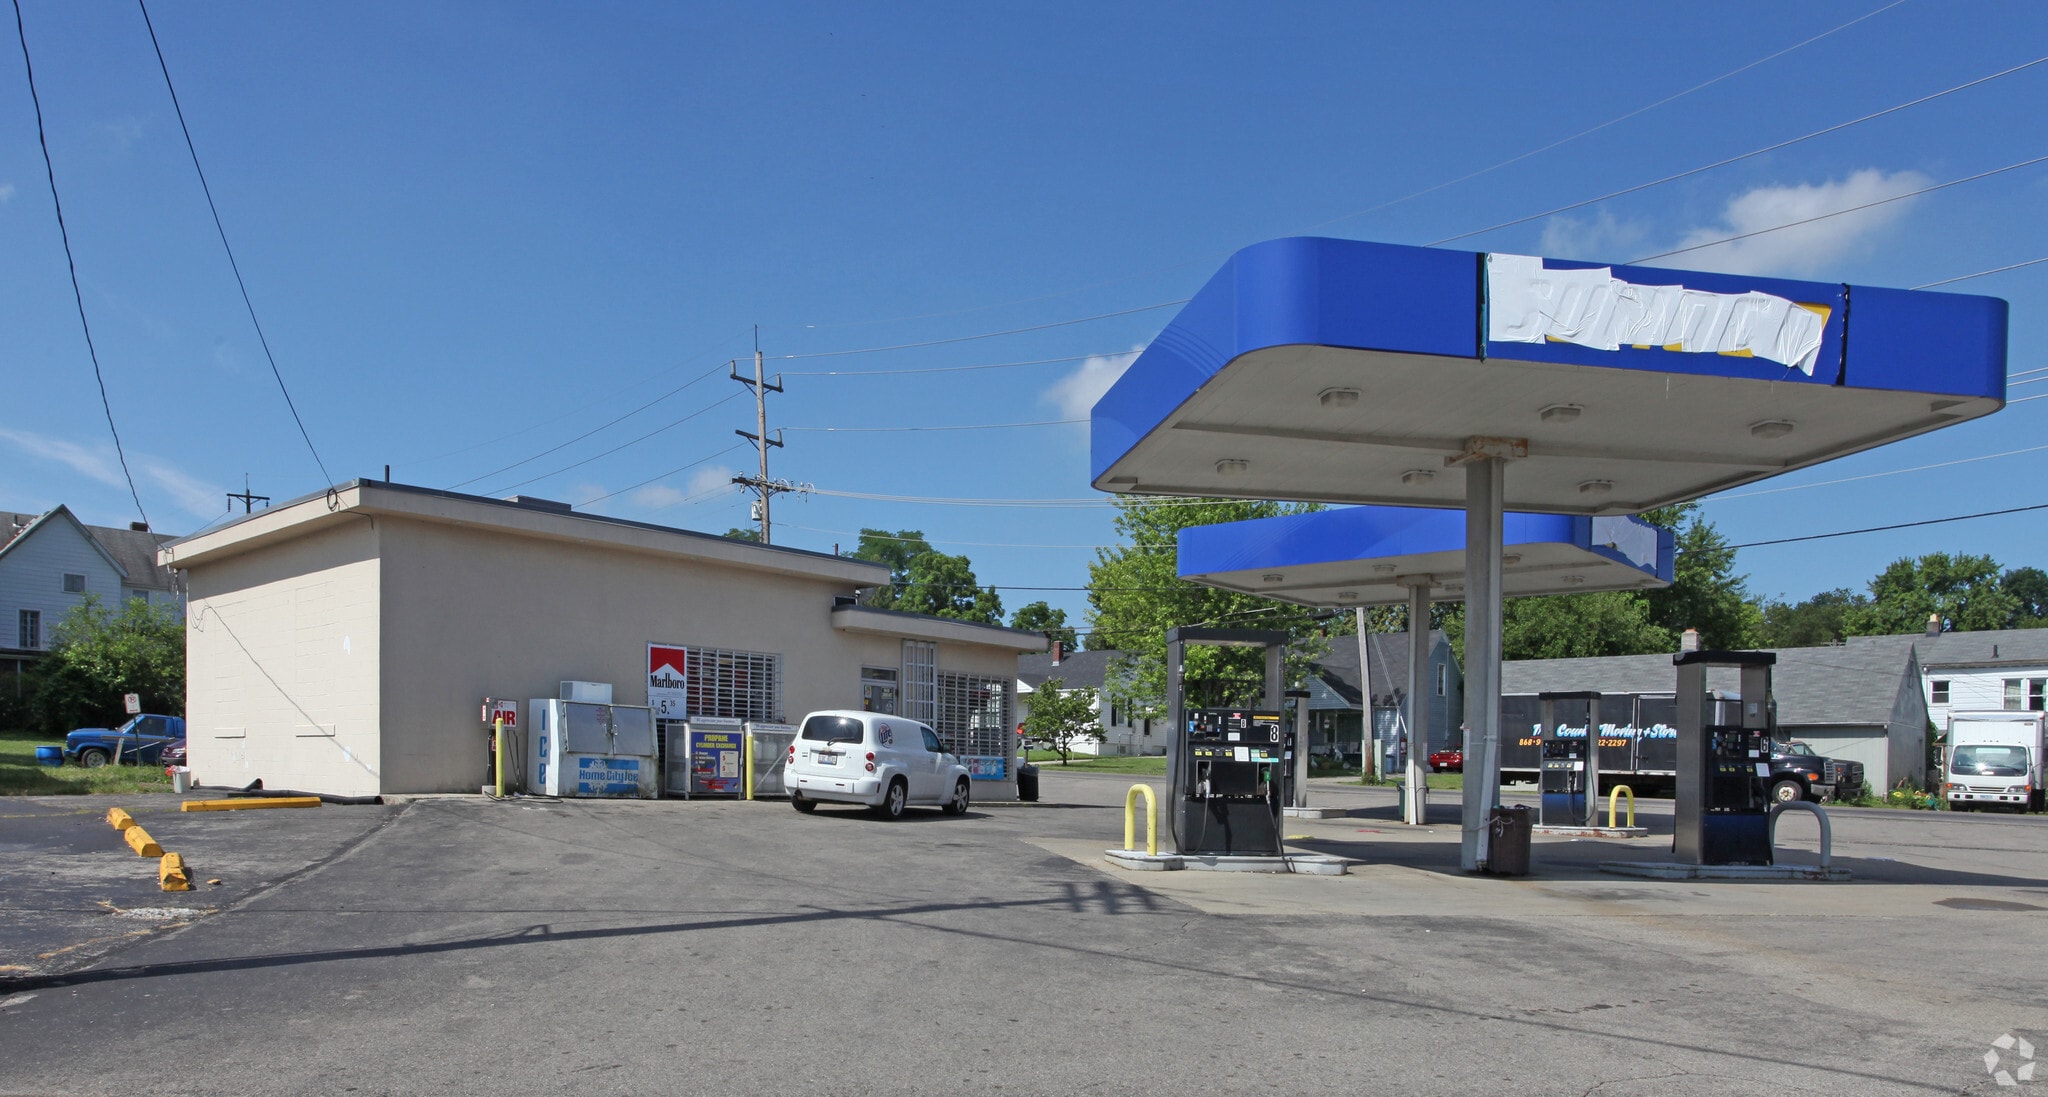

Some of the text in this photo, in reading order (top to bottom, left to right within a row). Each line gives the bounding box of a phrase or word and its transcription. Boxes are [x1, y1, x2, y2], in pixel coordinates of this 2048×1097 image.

[650, 673, 685, 689] Marlboro
[492, 709, 516, 725] AIR
[1270, 725, 1278, 742] 8
[1599, 723, 1643, 742] Moving
[579, 770, 639, 783] Home City Ice
